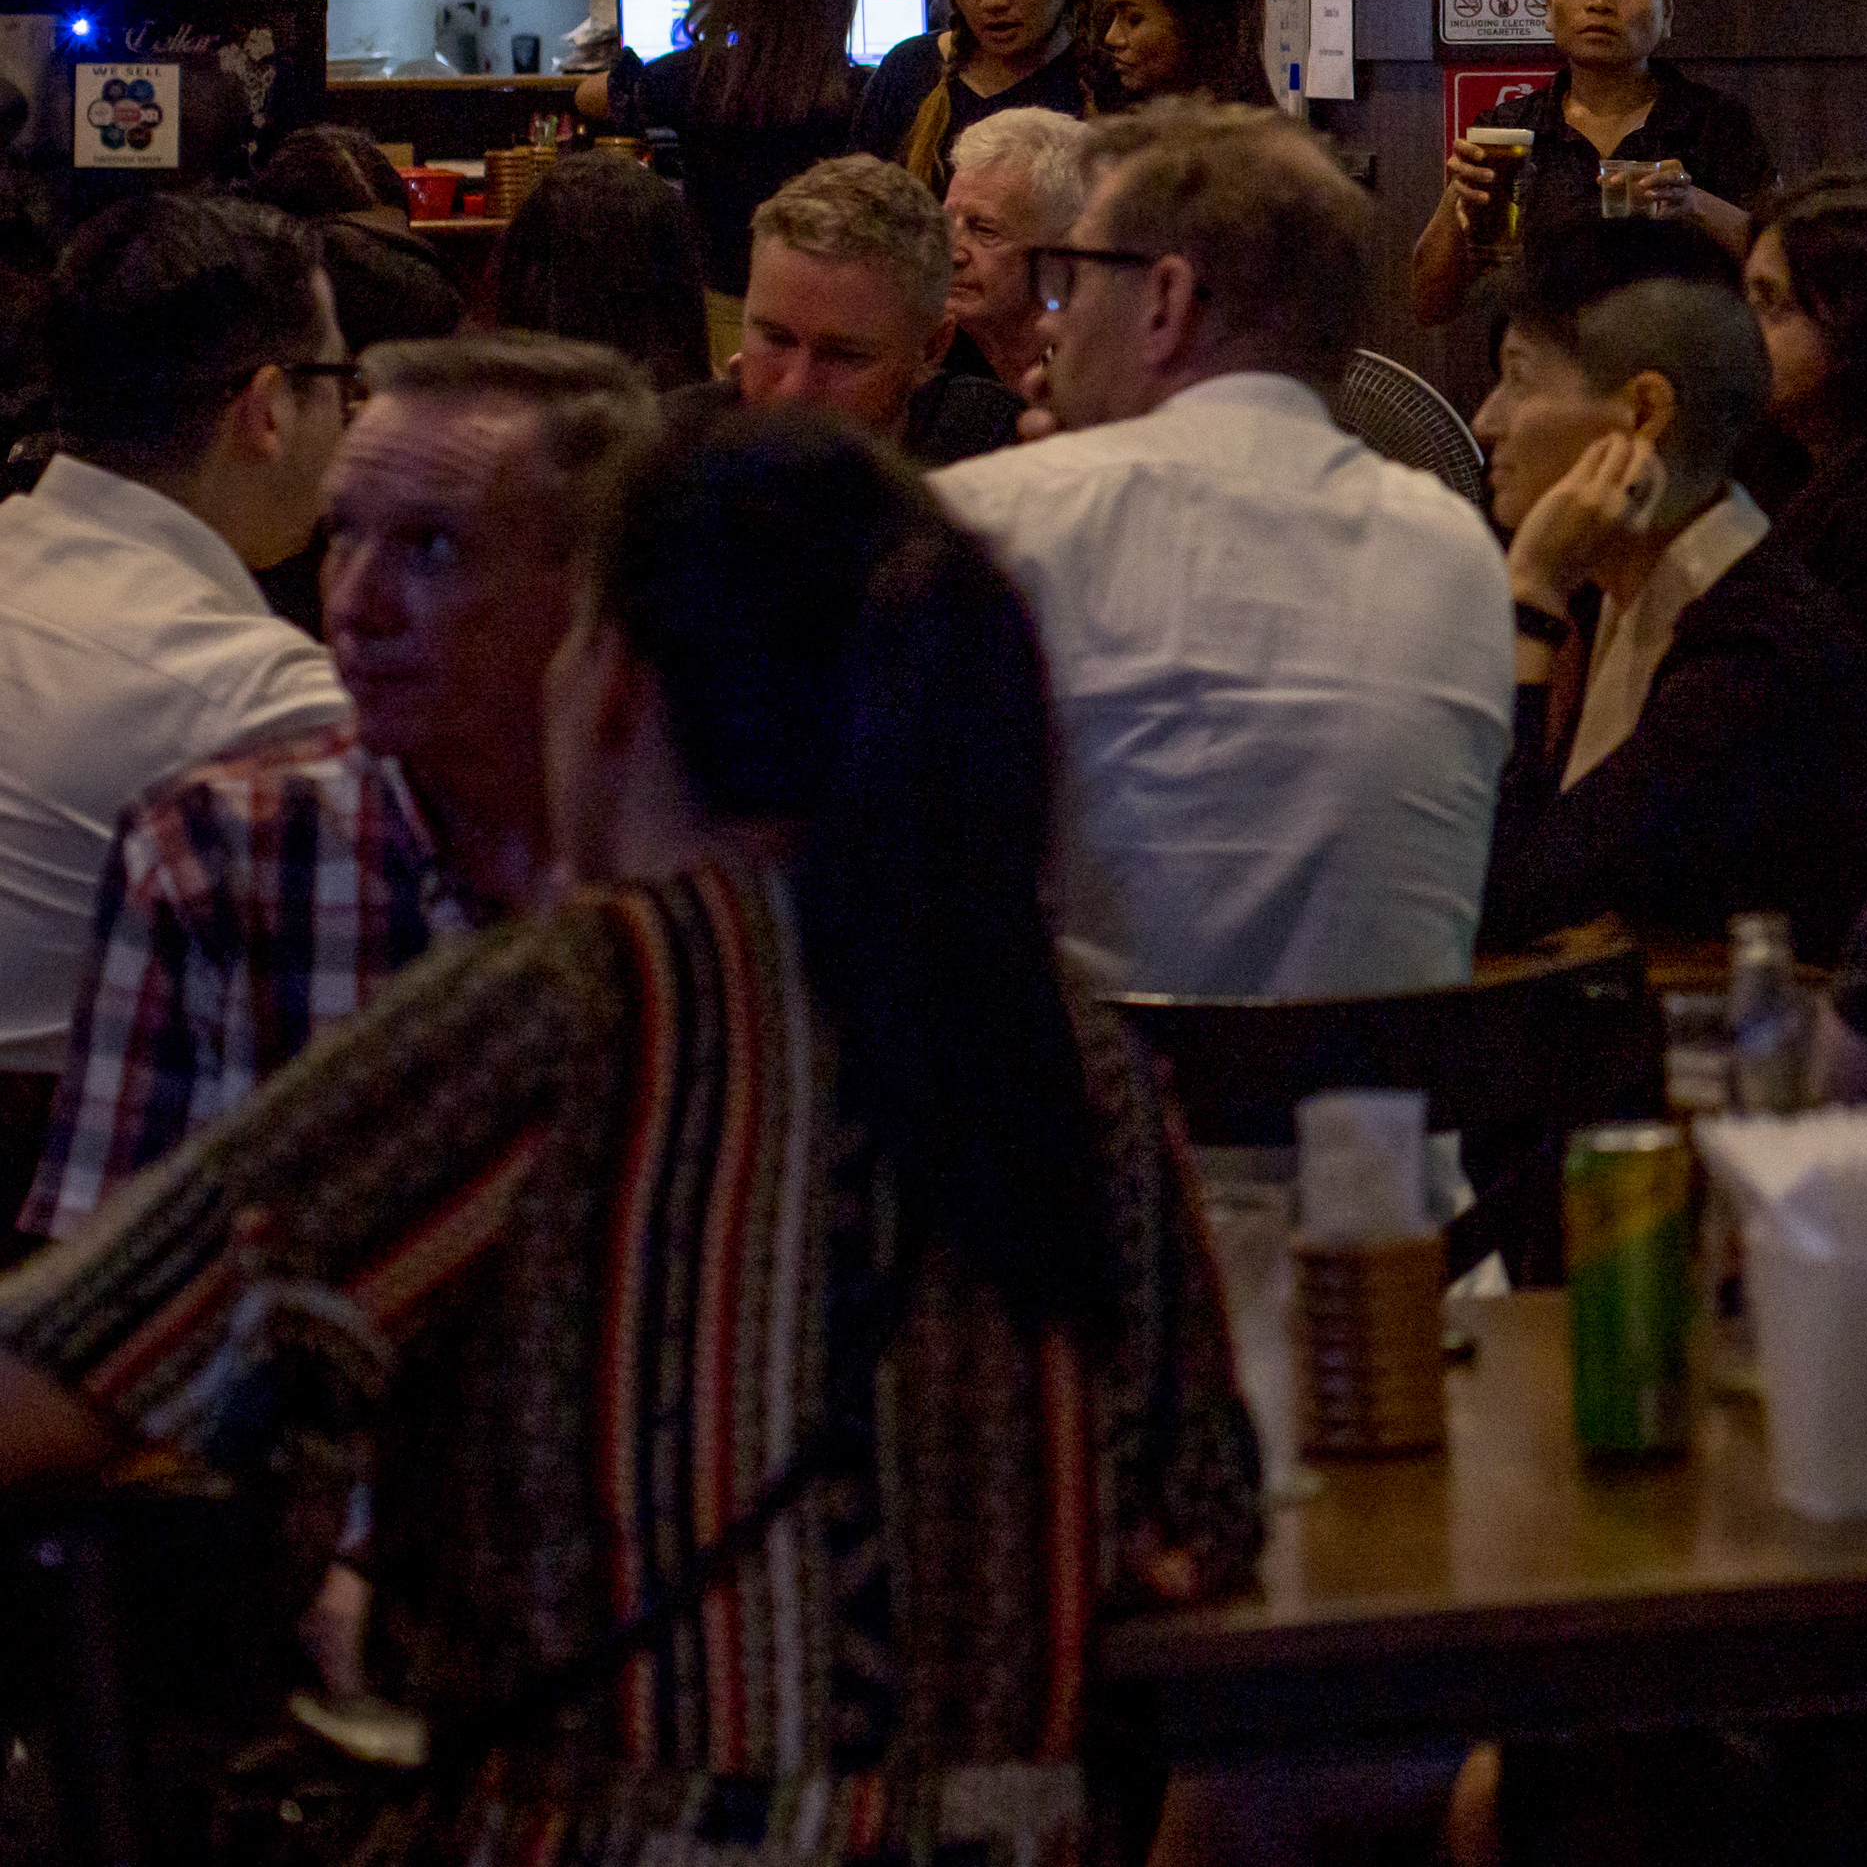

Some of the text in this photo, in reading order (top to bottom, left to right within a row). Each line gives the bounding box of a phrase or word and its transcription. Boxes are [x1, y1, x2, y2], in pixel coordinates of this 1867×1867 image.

[1451, 19, 1546, 27] INCLUDING ELECTRON
[1477, 28, 1531, 36] CIGARETTES
[93, 67, 162, 78] WE SELL
